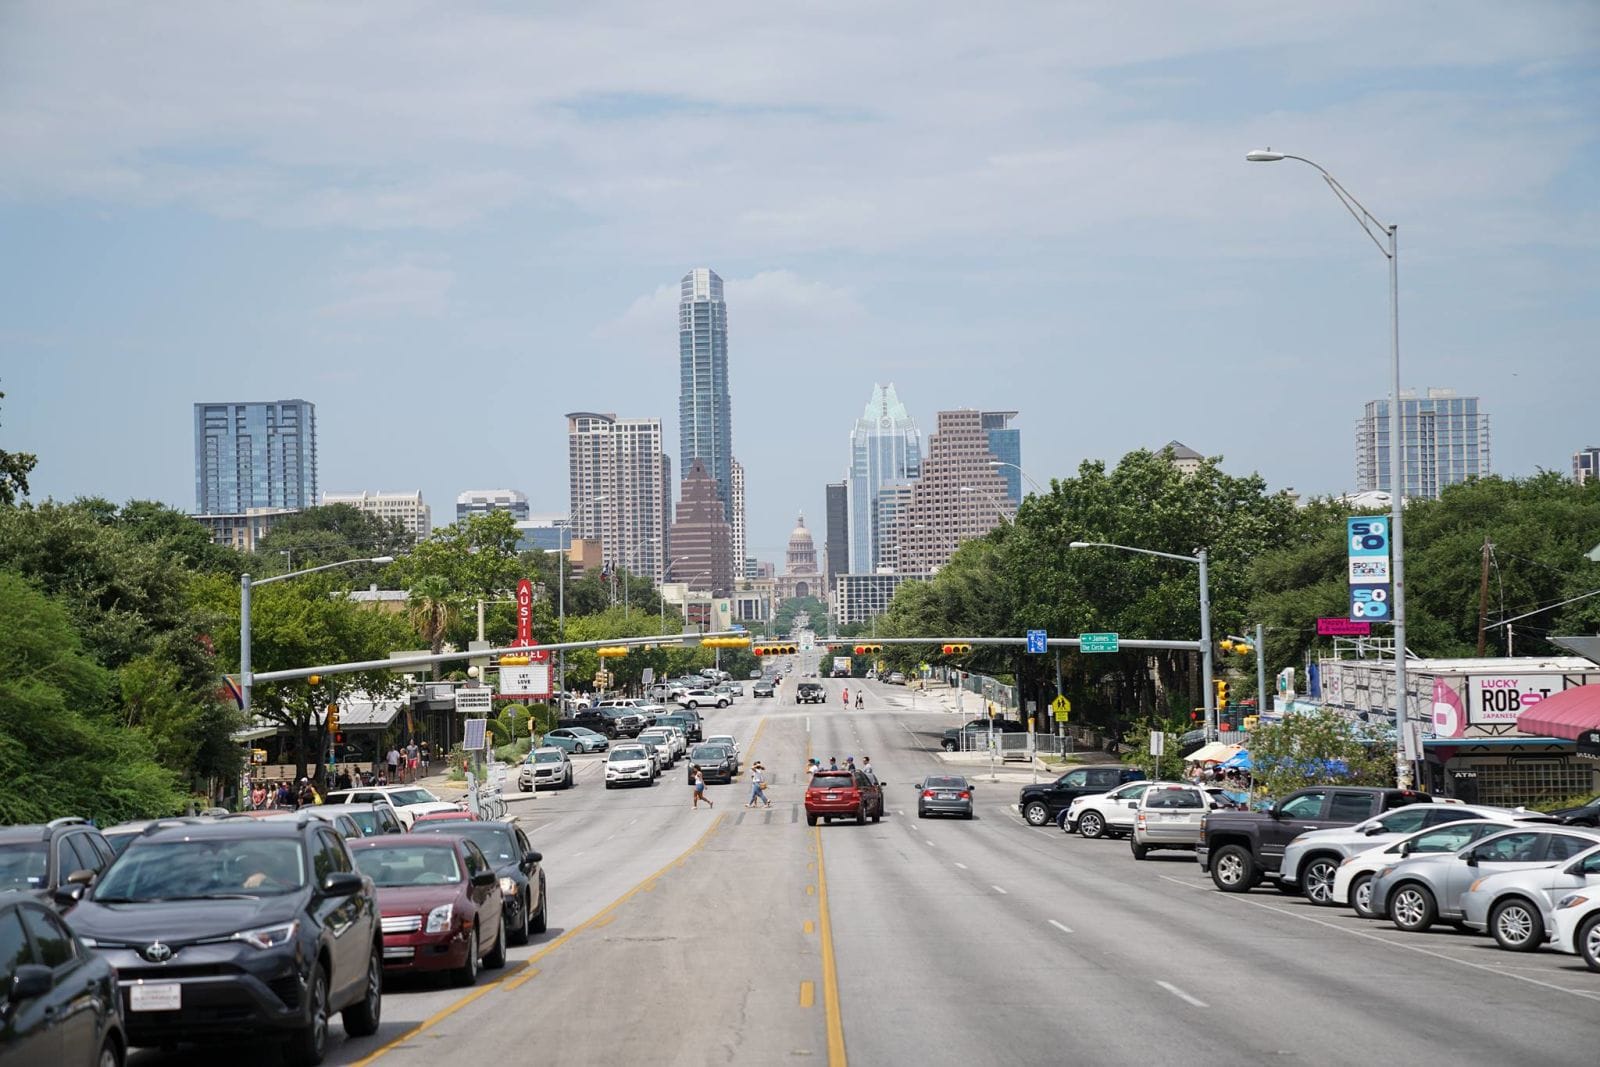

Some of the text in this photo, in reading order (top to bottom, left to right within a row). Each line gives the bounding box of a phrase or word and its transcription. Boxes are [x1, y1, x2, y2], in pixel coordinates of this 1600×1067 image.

[1351, 522, 1385, 535] SO
[1351, 535, 1385, 550] CO
[1353, 589, 1387, 601] SO
[1353, 601, 1387, 617] CO
[520, 585, 529, 648] AUSTIN
[1481, 679, 1519, 688] LUCKY
